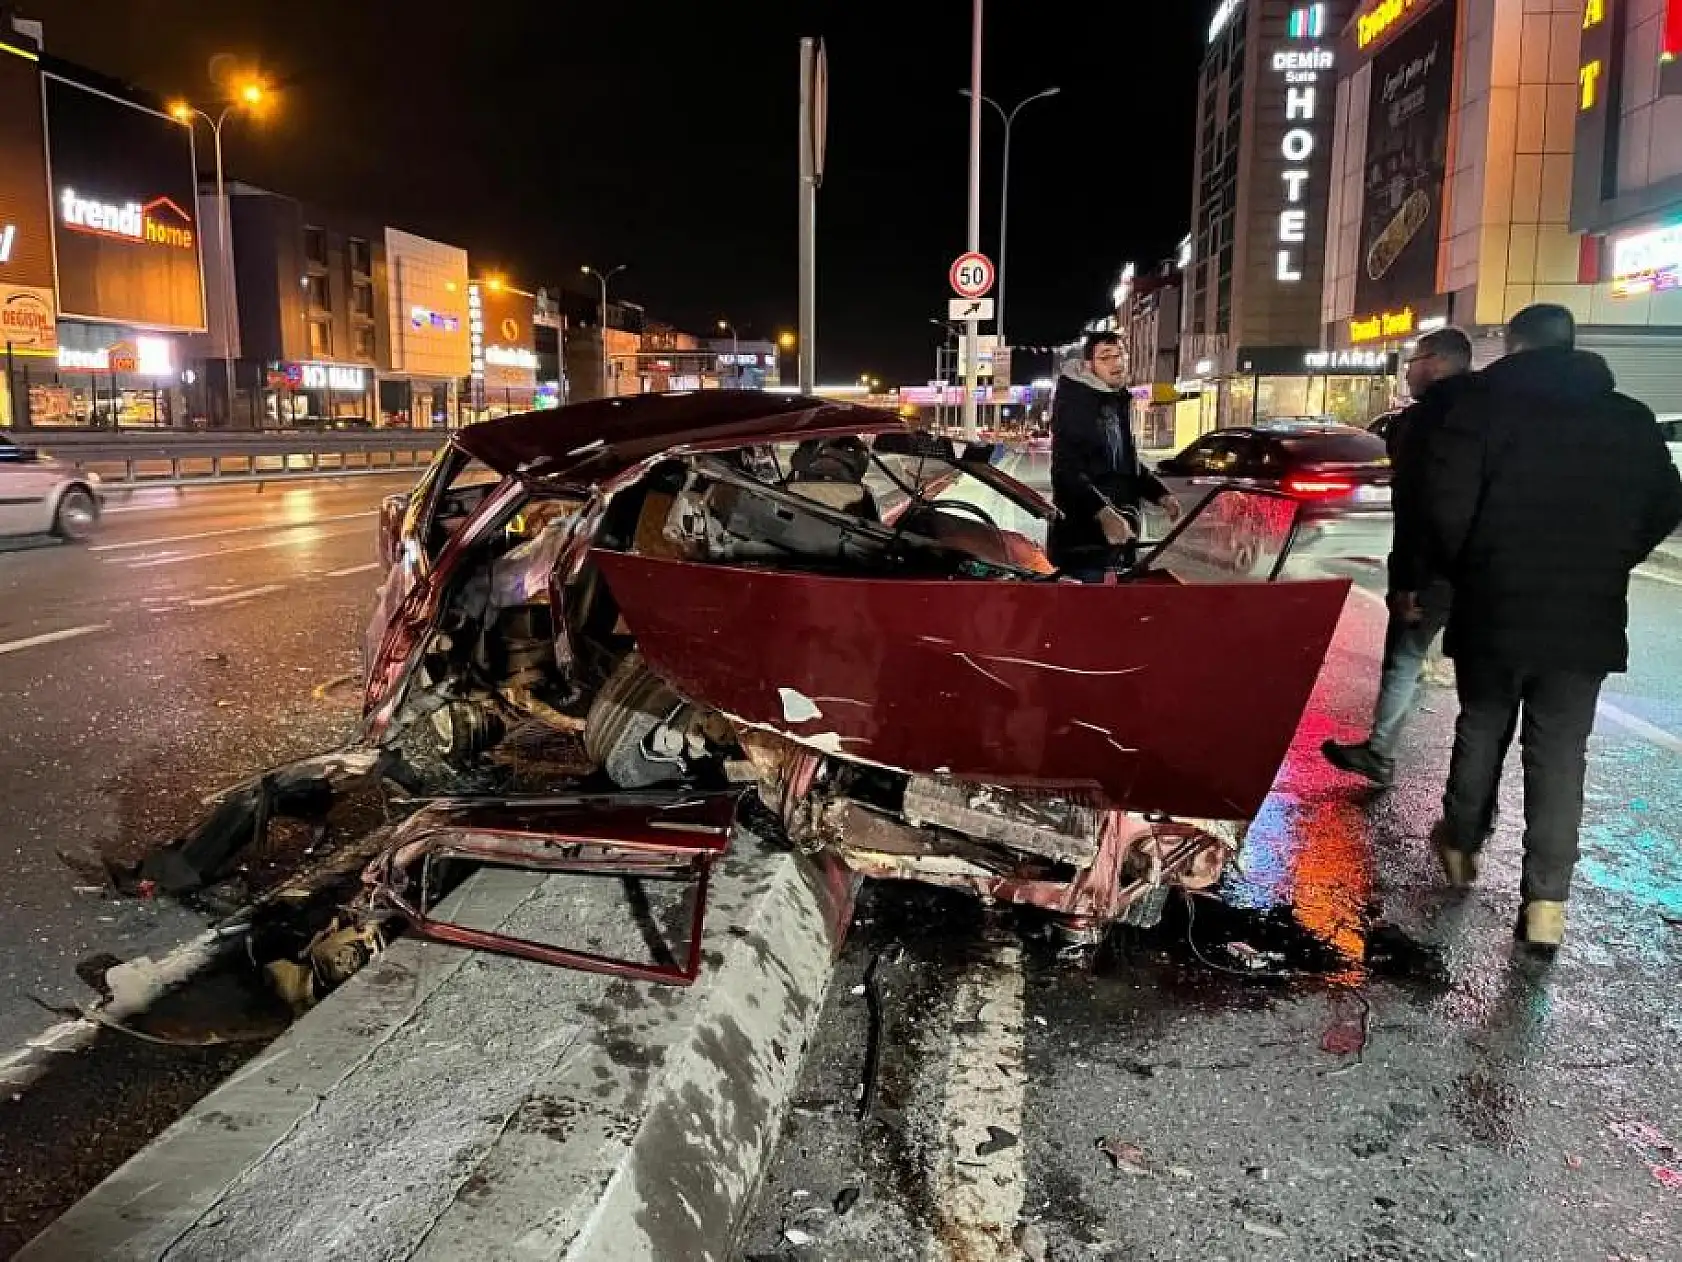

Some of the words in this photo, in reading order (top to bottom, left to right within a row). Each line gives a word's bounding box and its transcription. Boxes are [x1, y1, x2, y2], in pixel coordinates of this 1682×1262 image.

[1276, 86, 1316, 281] HOTEL
[61, 187, 142, 238] trendi
[145, 216, 193, 248] home
[960, 266, 983, 285] 50
